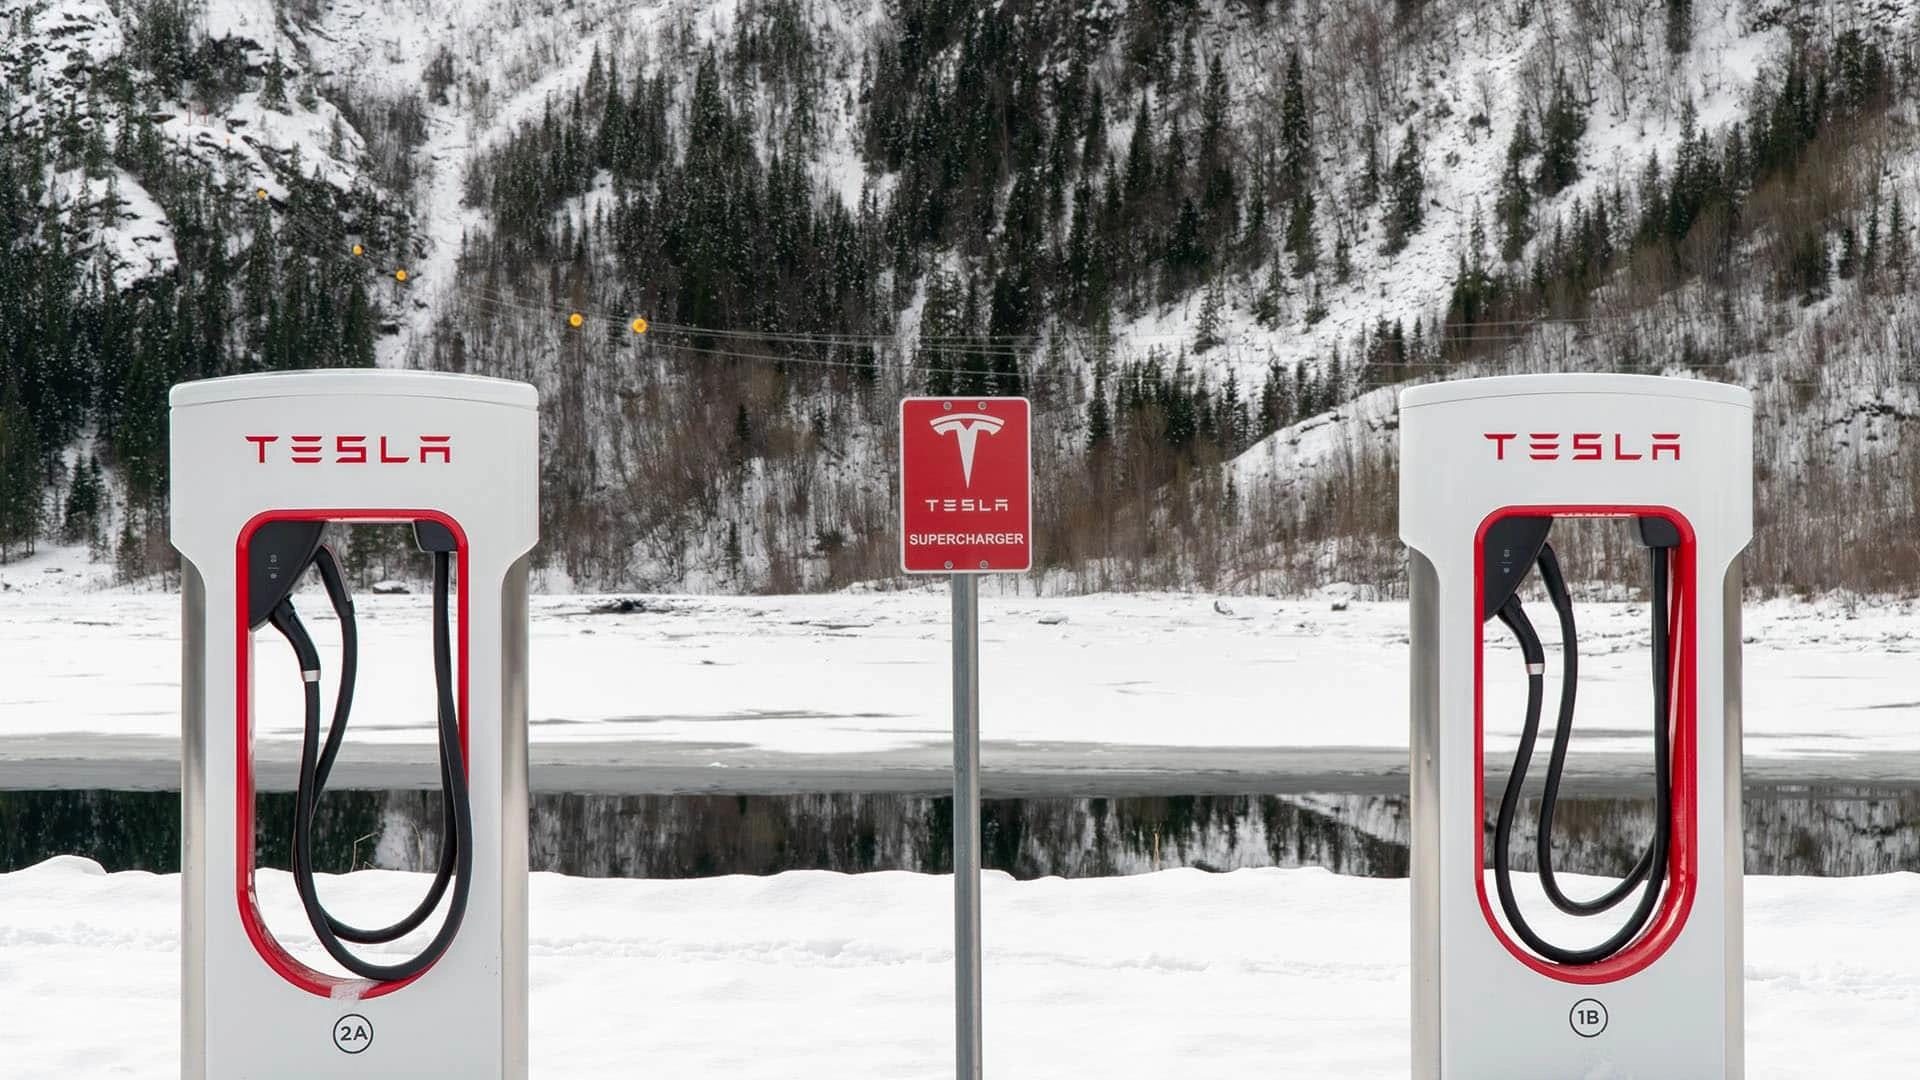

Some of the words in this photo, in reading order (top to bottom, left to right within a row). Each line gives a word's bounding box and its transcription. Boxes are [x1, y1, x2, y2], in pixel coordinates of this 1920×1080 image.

[245, 435, 451, 464] TESLA
[1484, 433, 1681, 460] TESLA
[925, 499, 1009, 512] TESLA
[909, 533, 1024, 545] SUPERCHARGER
[1577, 1009, 1600, 1025] 1B
[340, 1025, 368, 1041] 2A
